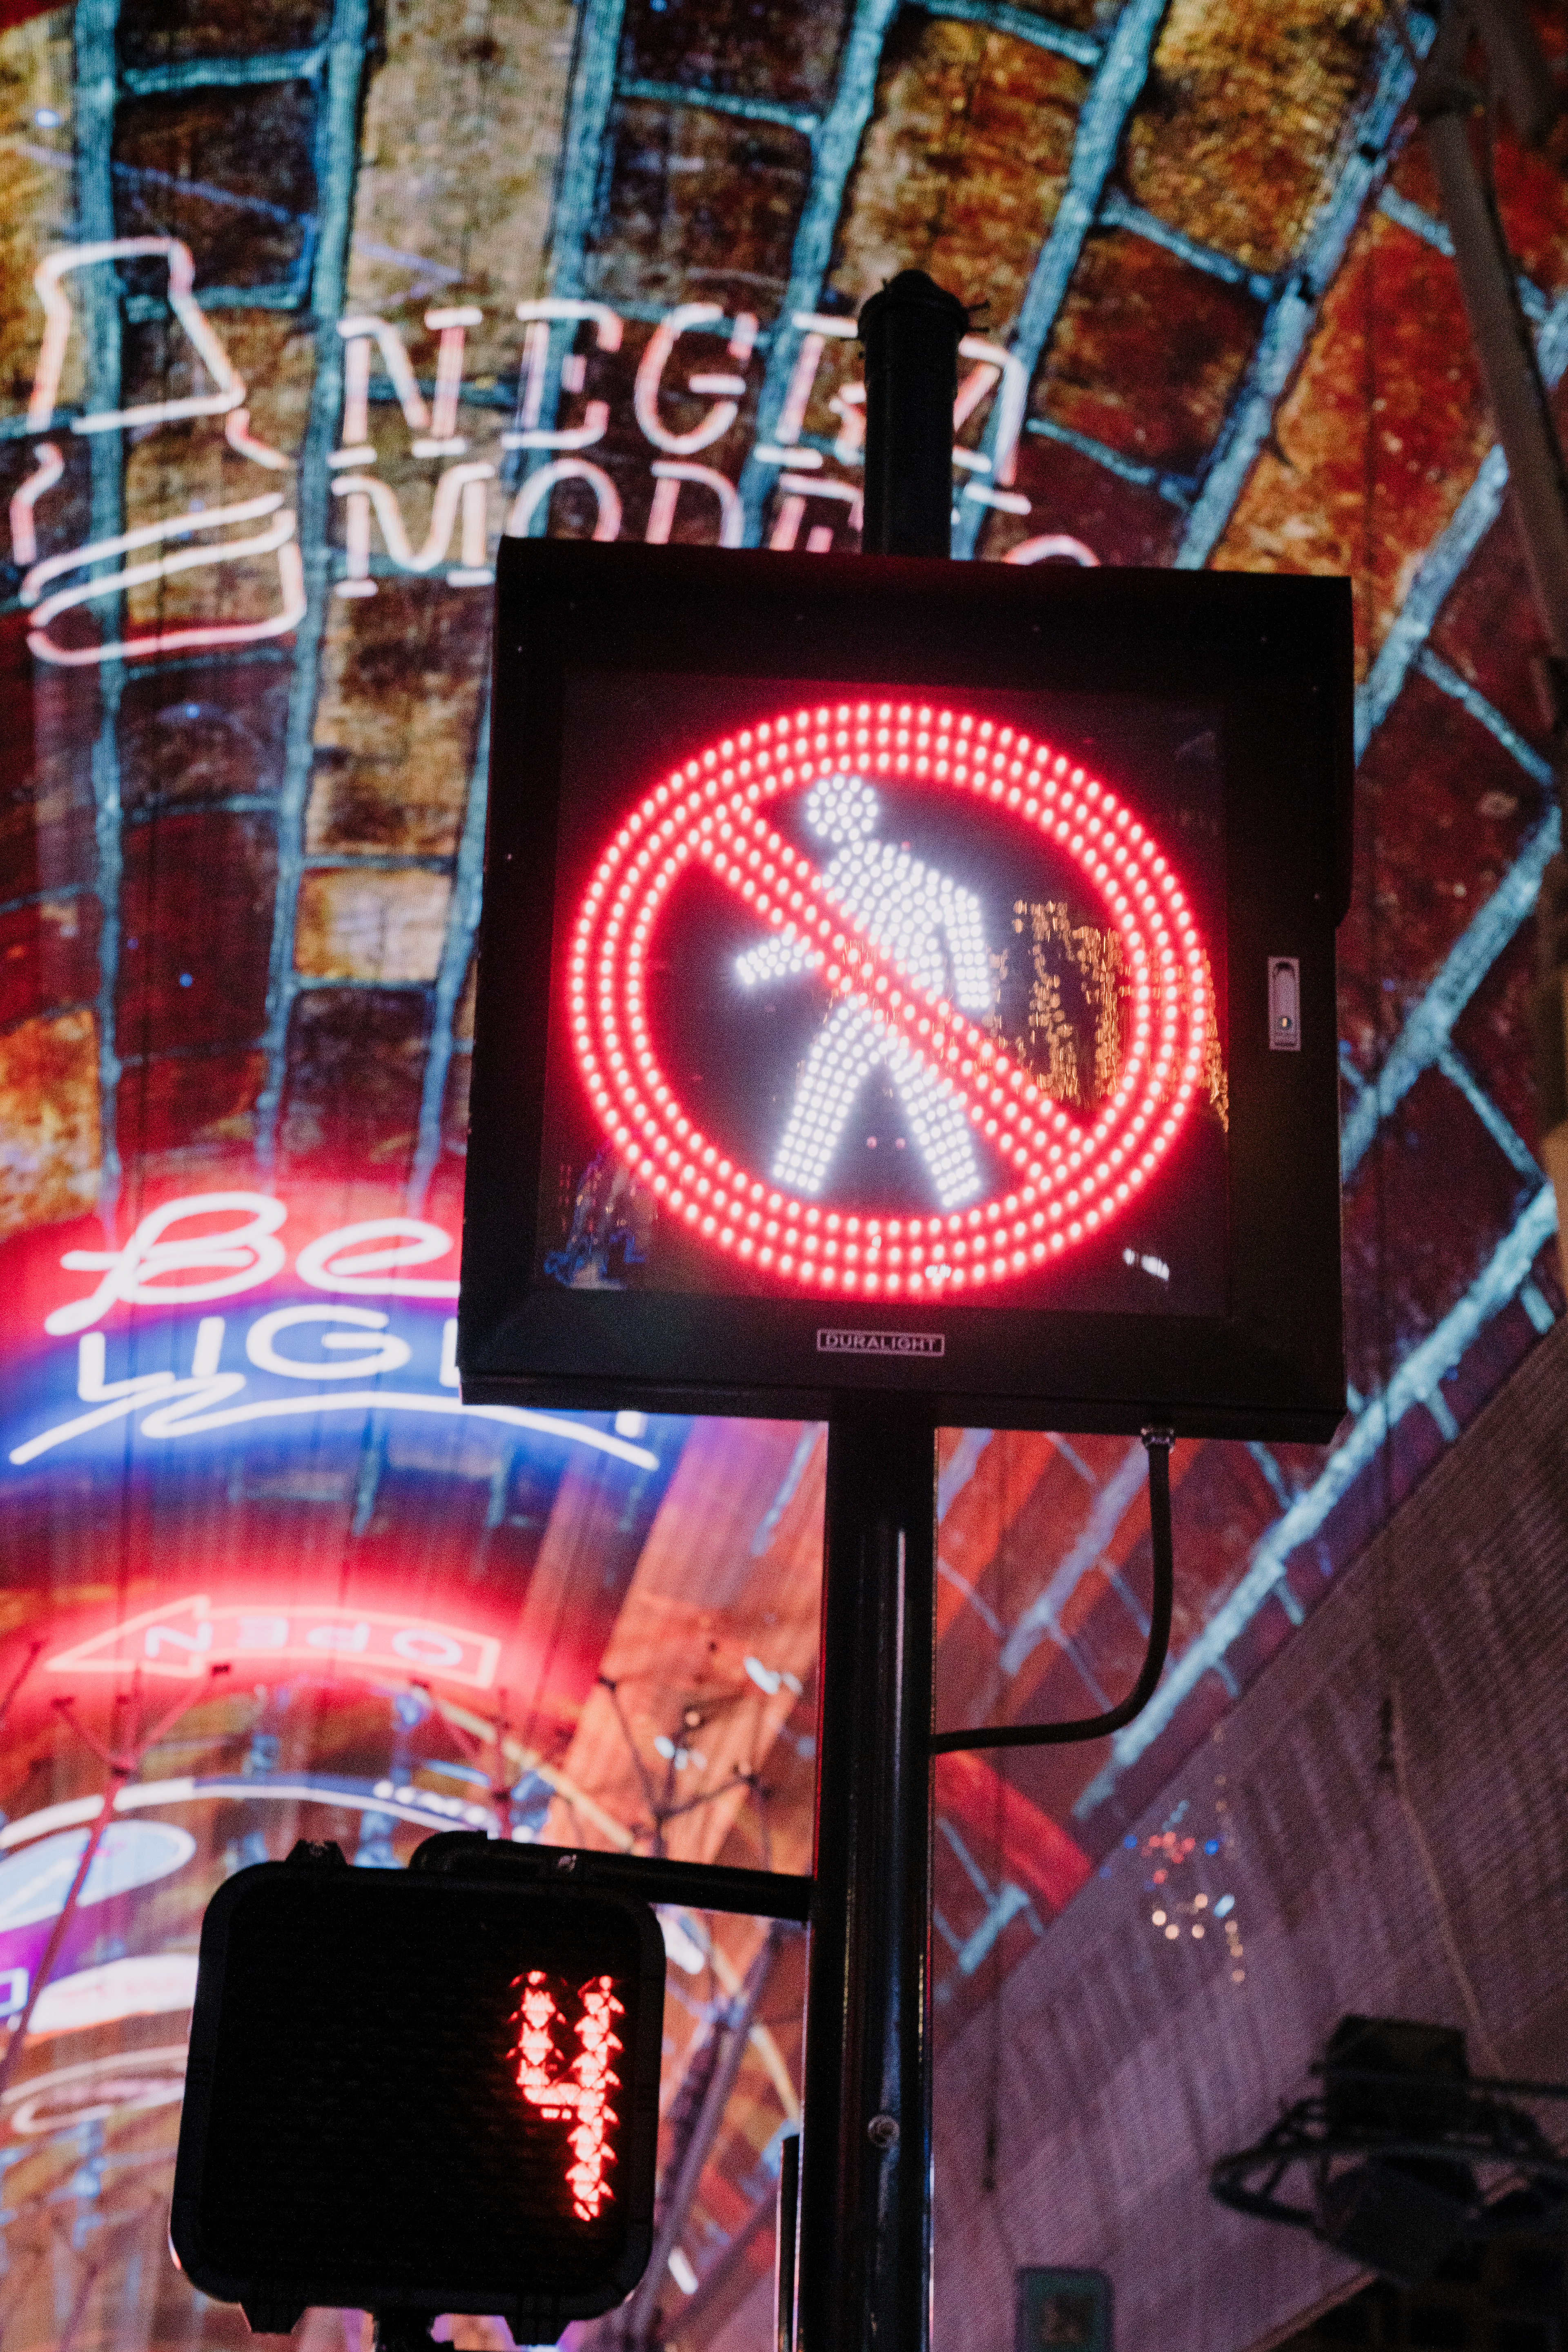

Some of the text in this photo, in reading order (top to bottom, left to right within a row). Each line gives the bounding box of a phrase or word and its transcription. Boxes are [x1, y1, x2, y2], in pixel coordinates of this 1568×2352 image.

[825, 1332, 936, 1352] DURALIGHT
[145, 1616, 463, 1667] OPEN
[506, 1970, 625, 2221] 4
